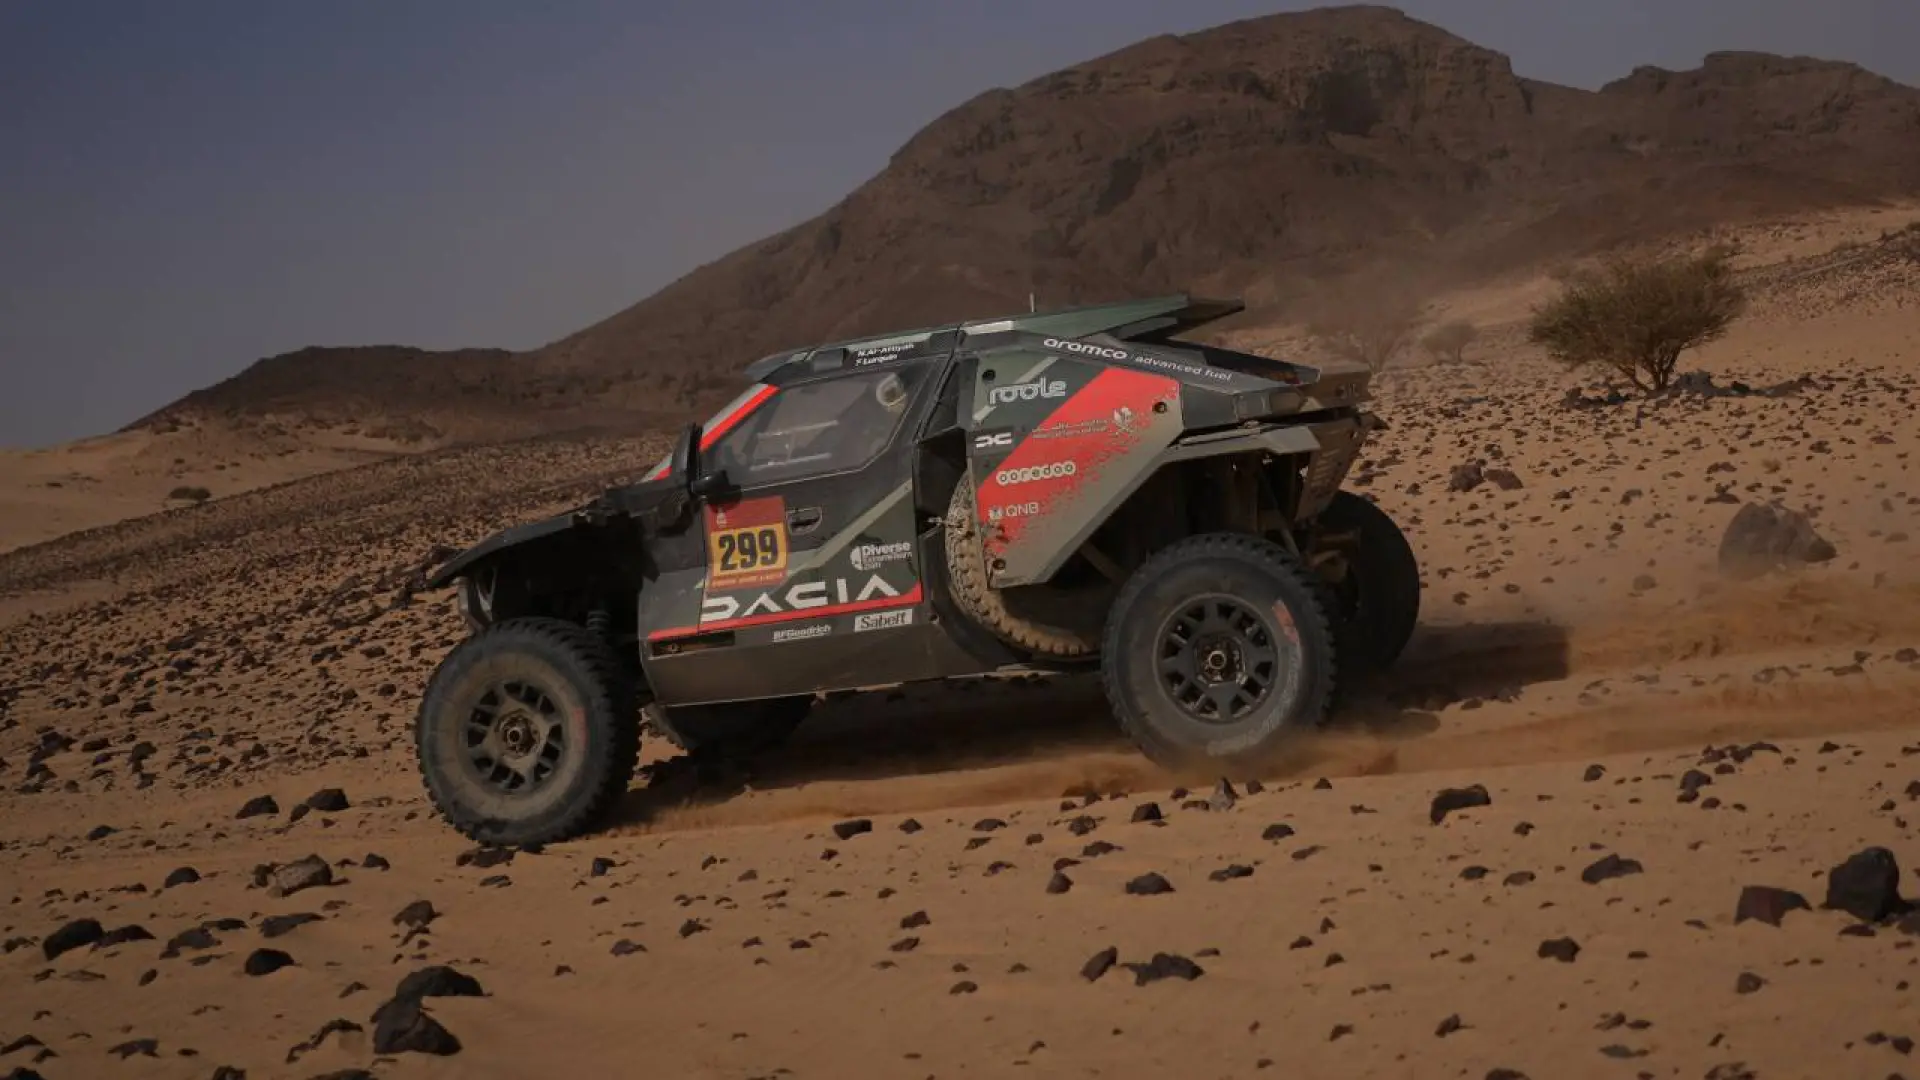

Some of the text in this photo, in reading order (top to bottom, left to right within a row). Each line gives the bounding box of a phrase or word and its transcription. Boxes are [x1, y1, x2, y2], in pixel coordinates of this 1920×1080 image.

[1043, 338, 1232, 381] aramco advanced fuel
[997, 461, 1076, 485] ooredoo
[1006, 502, 1039, 517] QNB
[718, 529, 779, 571] 299
[862, 542, 911, 556] Diverse
[701, 574, 900, 622] DACIA
[860, 611, 906, 630] Sabelt
